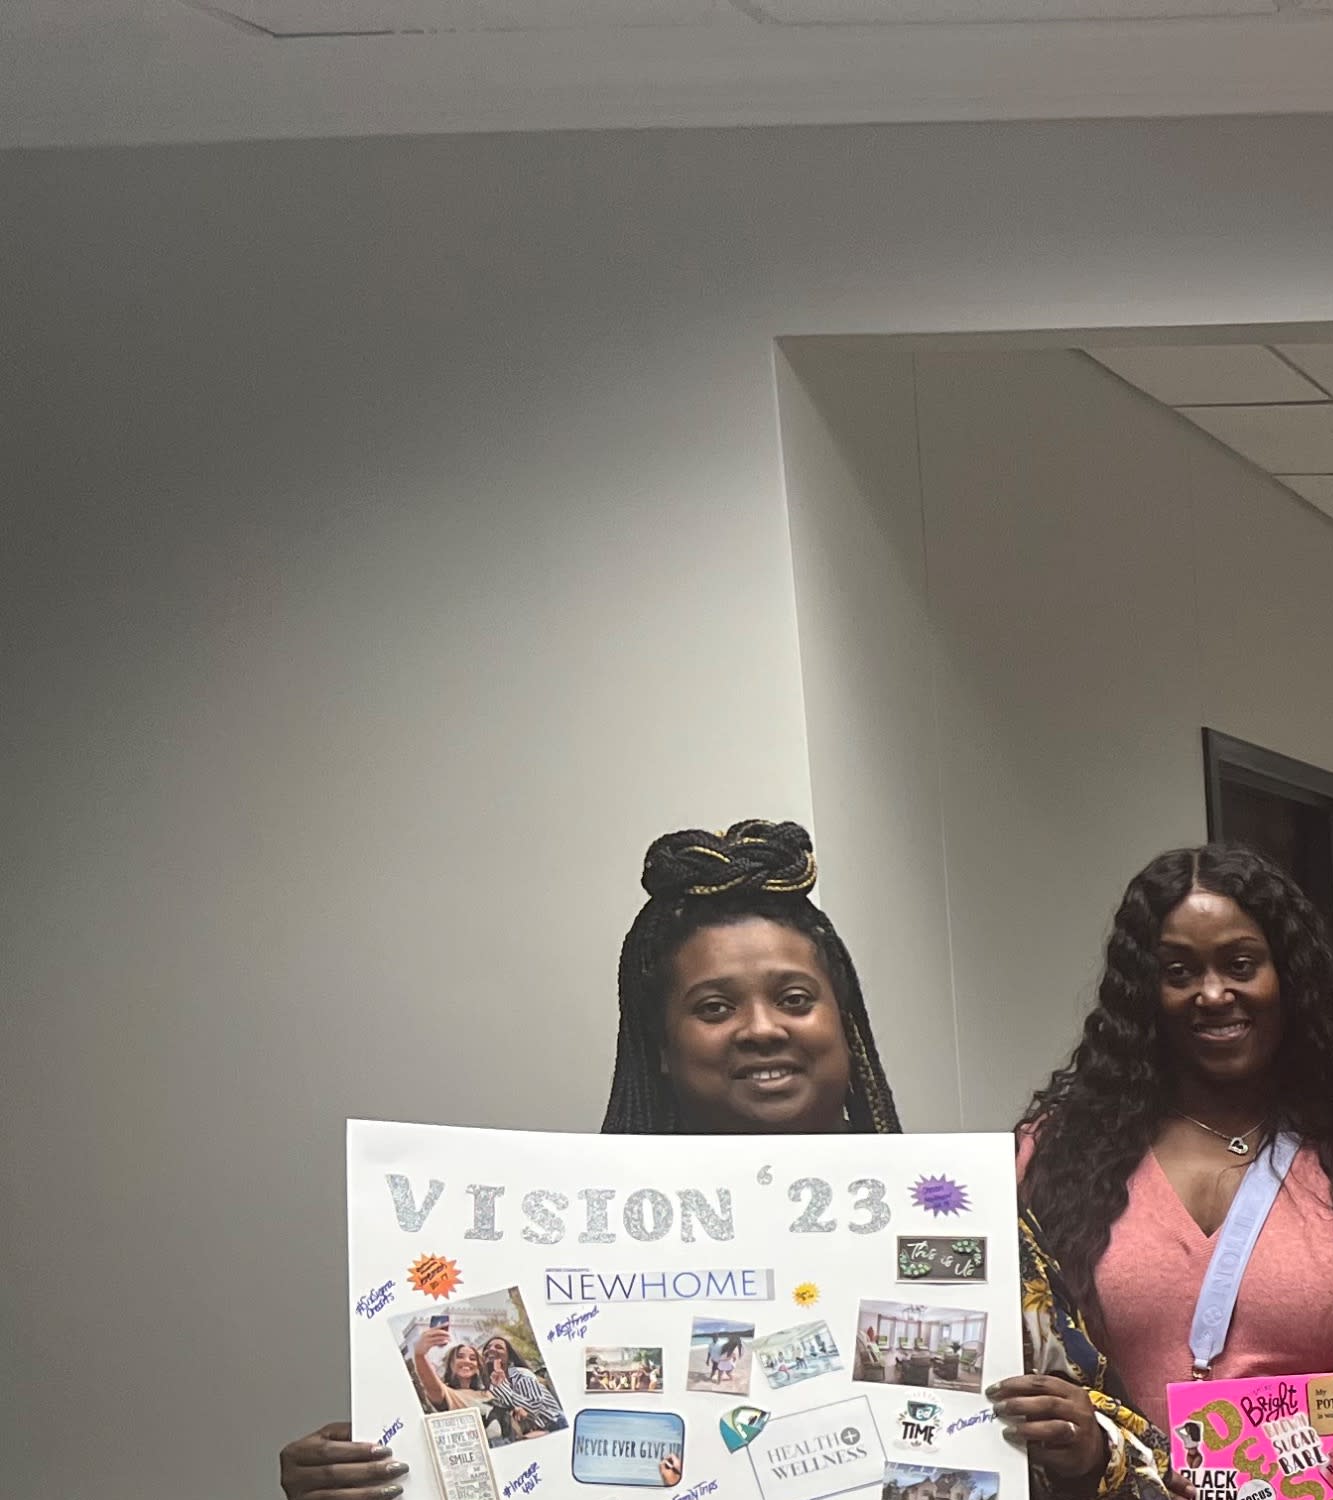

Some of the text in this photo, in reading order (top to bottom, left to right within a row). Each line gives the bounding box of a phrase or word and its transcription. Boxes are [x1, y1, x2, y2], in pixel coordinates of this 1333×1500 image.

[385, 1173, 734, 1244] VISION
[901, 1421, 936, 1445] TIME
[771, 1446, 868, 1480] WELLNESS
[1278, 1449, 1327, 1476] BABE
